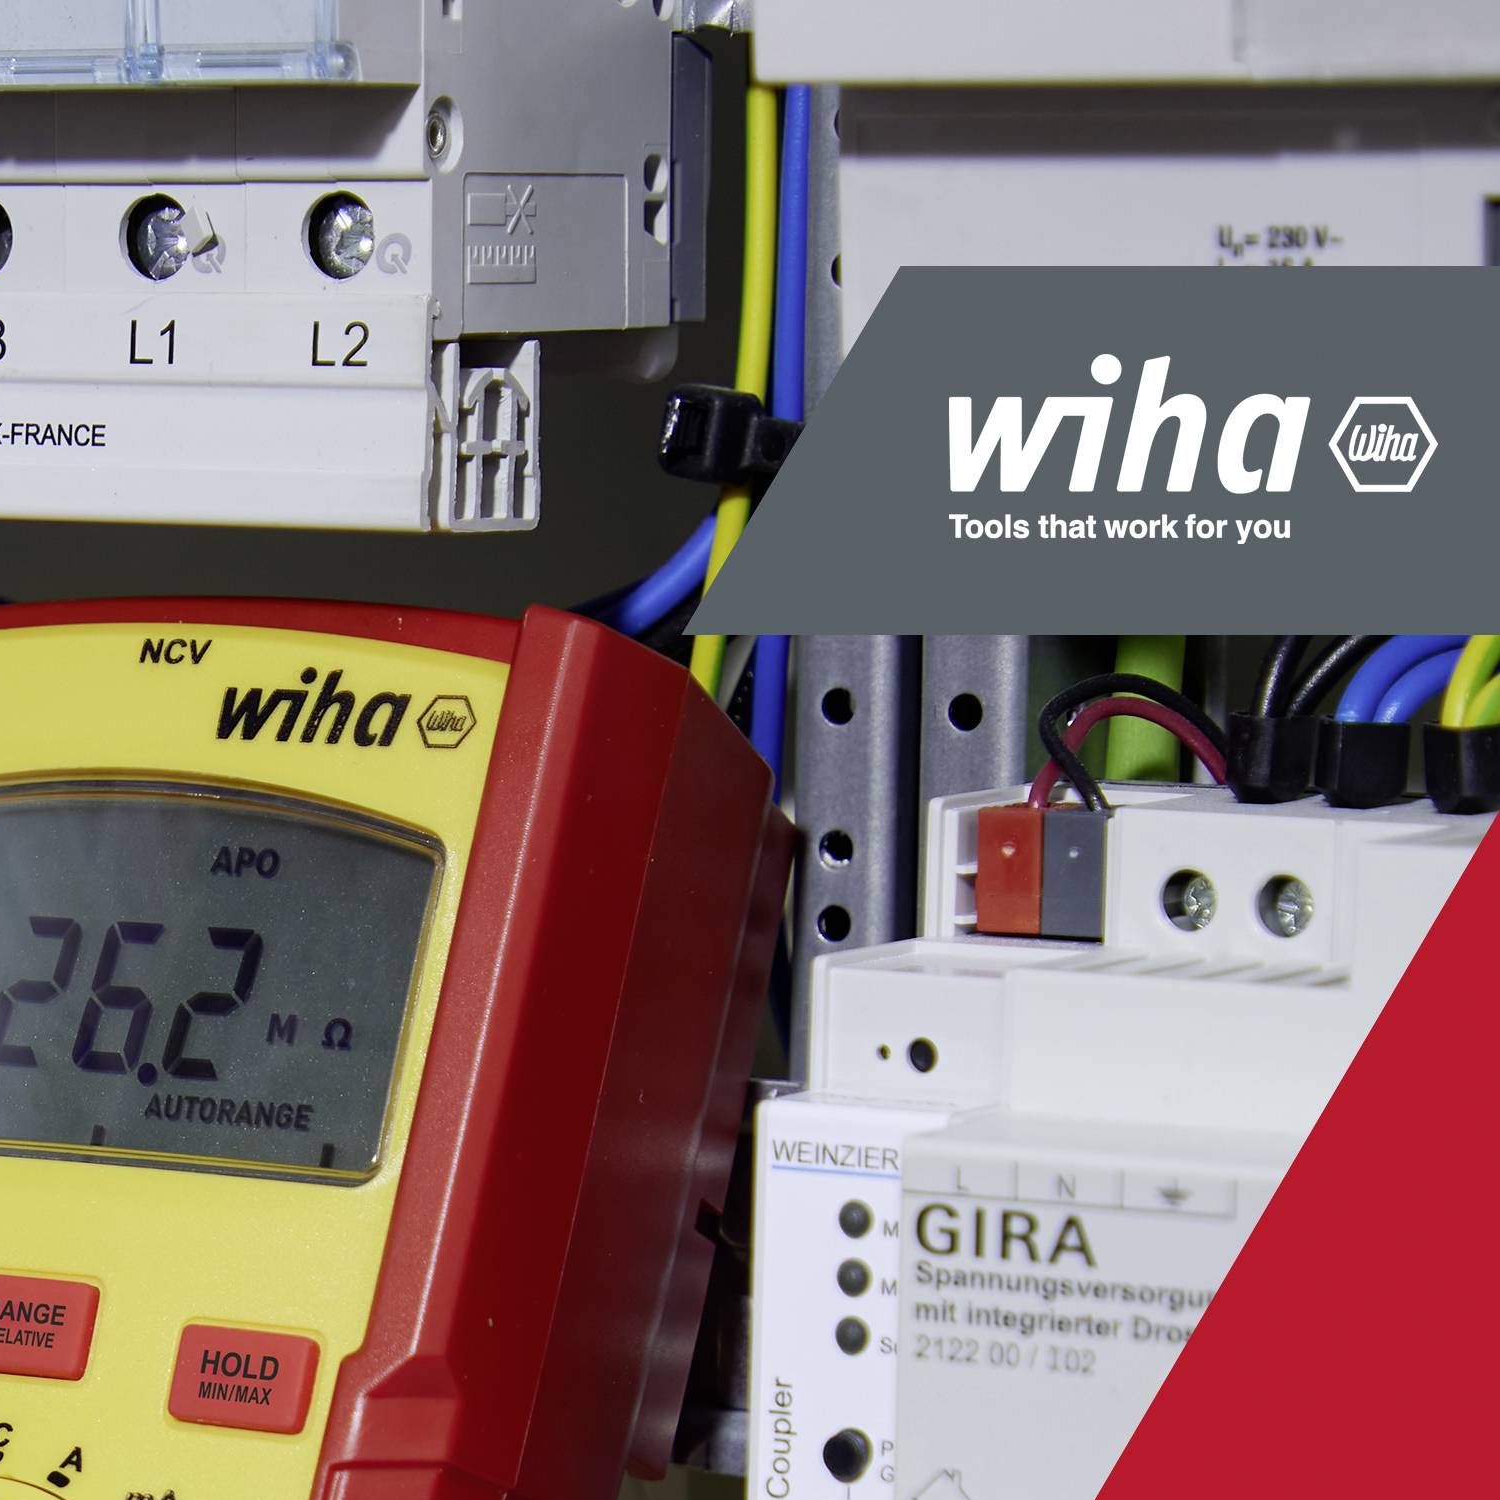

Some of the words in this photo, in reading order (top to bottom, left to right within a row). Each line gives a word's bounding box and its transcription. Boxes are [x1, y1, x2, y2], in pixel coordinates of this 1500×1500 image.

[129, 319, 177, 365] L1
[312, 321, 369, 367] L2
[139, 638, 212, 664] NCV
[216, 667, 412, 747] wiha
[210, 846, 280, 879] APO
[266, 1013, 297, 1046] M
[145, 1093, 313, 1132] AUTORANGE
[955, 1166, 970, 1192] L
[1057, 1174, 1076, 1200] N
[915, 1203, 1097, 1268] GIRA
[915, 1300, 957, 1323] mit
[967, 1302, 1121, 1337] integrierter
[200, 1349, 280, 1382] HOLD
[915, 1333, 979, 1363] 2122
[989, 1341, 1021, 1367] 00
[198, 1380, 272, 1406] MIN/MAX
[60, 1447, 83, 1472] A
